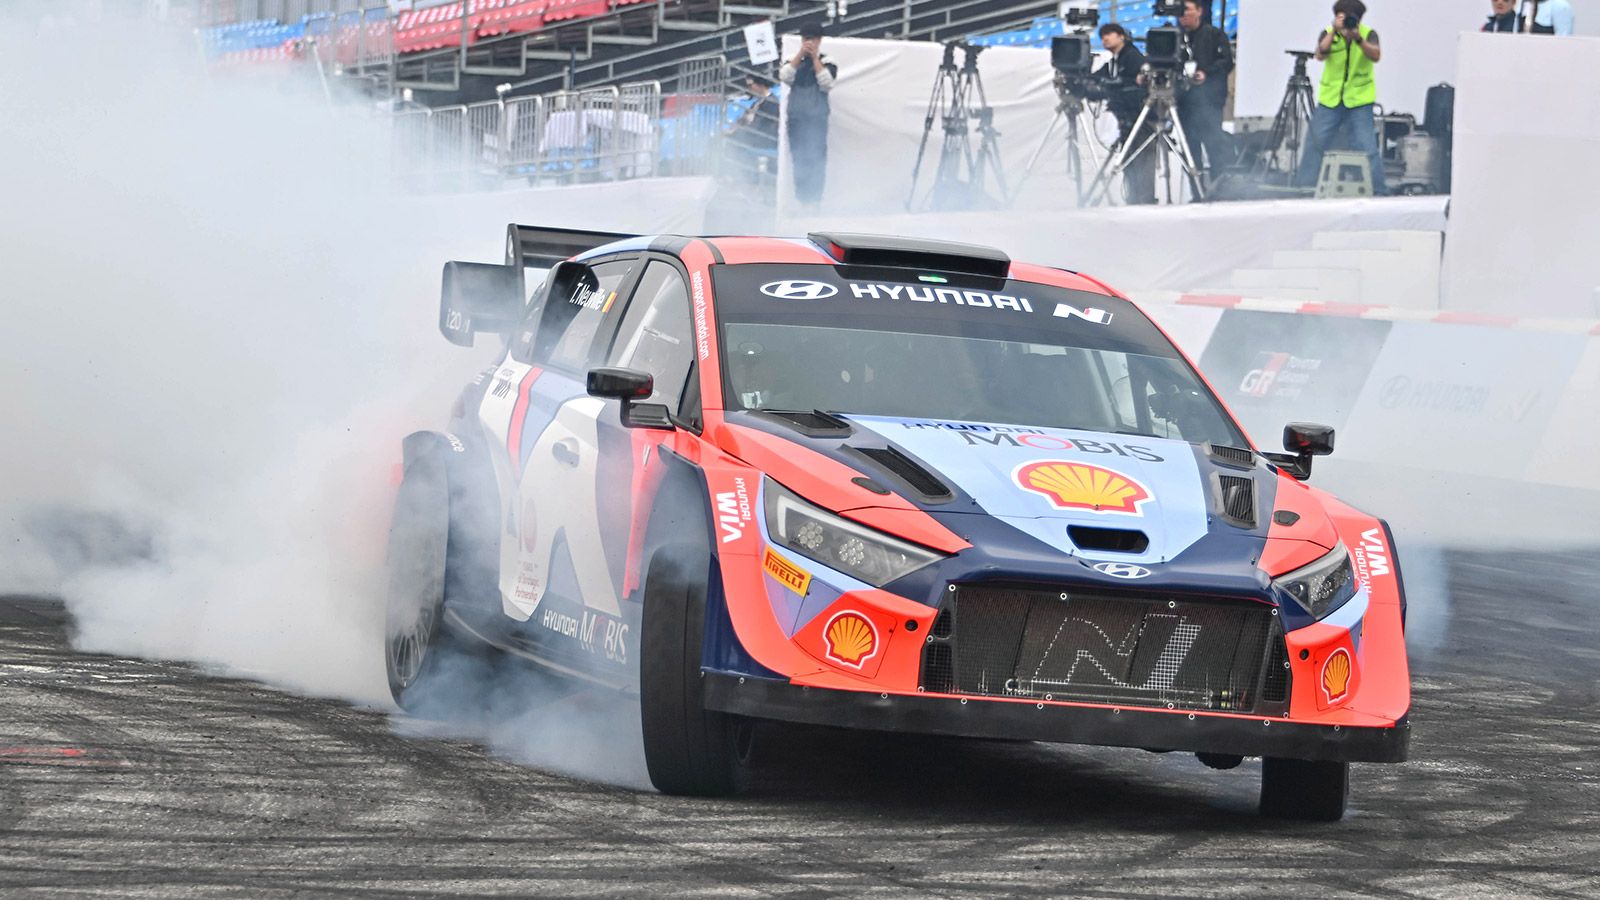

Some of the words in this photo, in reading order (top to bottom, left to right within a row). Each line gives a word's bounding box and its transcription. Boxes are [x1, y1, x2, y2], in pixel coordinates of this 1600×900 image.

[569, 282, 584, 303] T.
[849, 283, 1034, 313] HYUNDAI
[446, 307, 462, 331] i20
[692, 270, 710, 361] motorsport.hyundai.com
[1240, 368, 1277, 397] GR
[902, 422, 1046, 435] HYUNDAI
[958, 430, 1165, 463] MOBIS
[716, 491, 746, 544] WIA
[735, 477, 752, 521] HYUNDAI
[764, 551, 806, 590] PIRELLI
[1354, 547, 1373, 594] HYUNDAI
[1360, 527, 1390, 577] WIA
[543, 608, 578, 639] HYUNDAI
[579, 611, 629, 664] MOBIS
